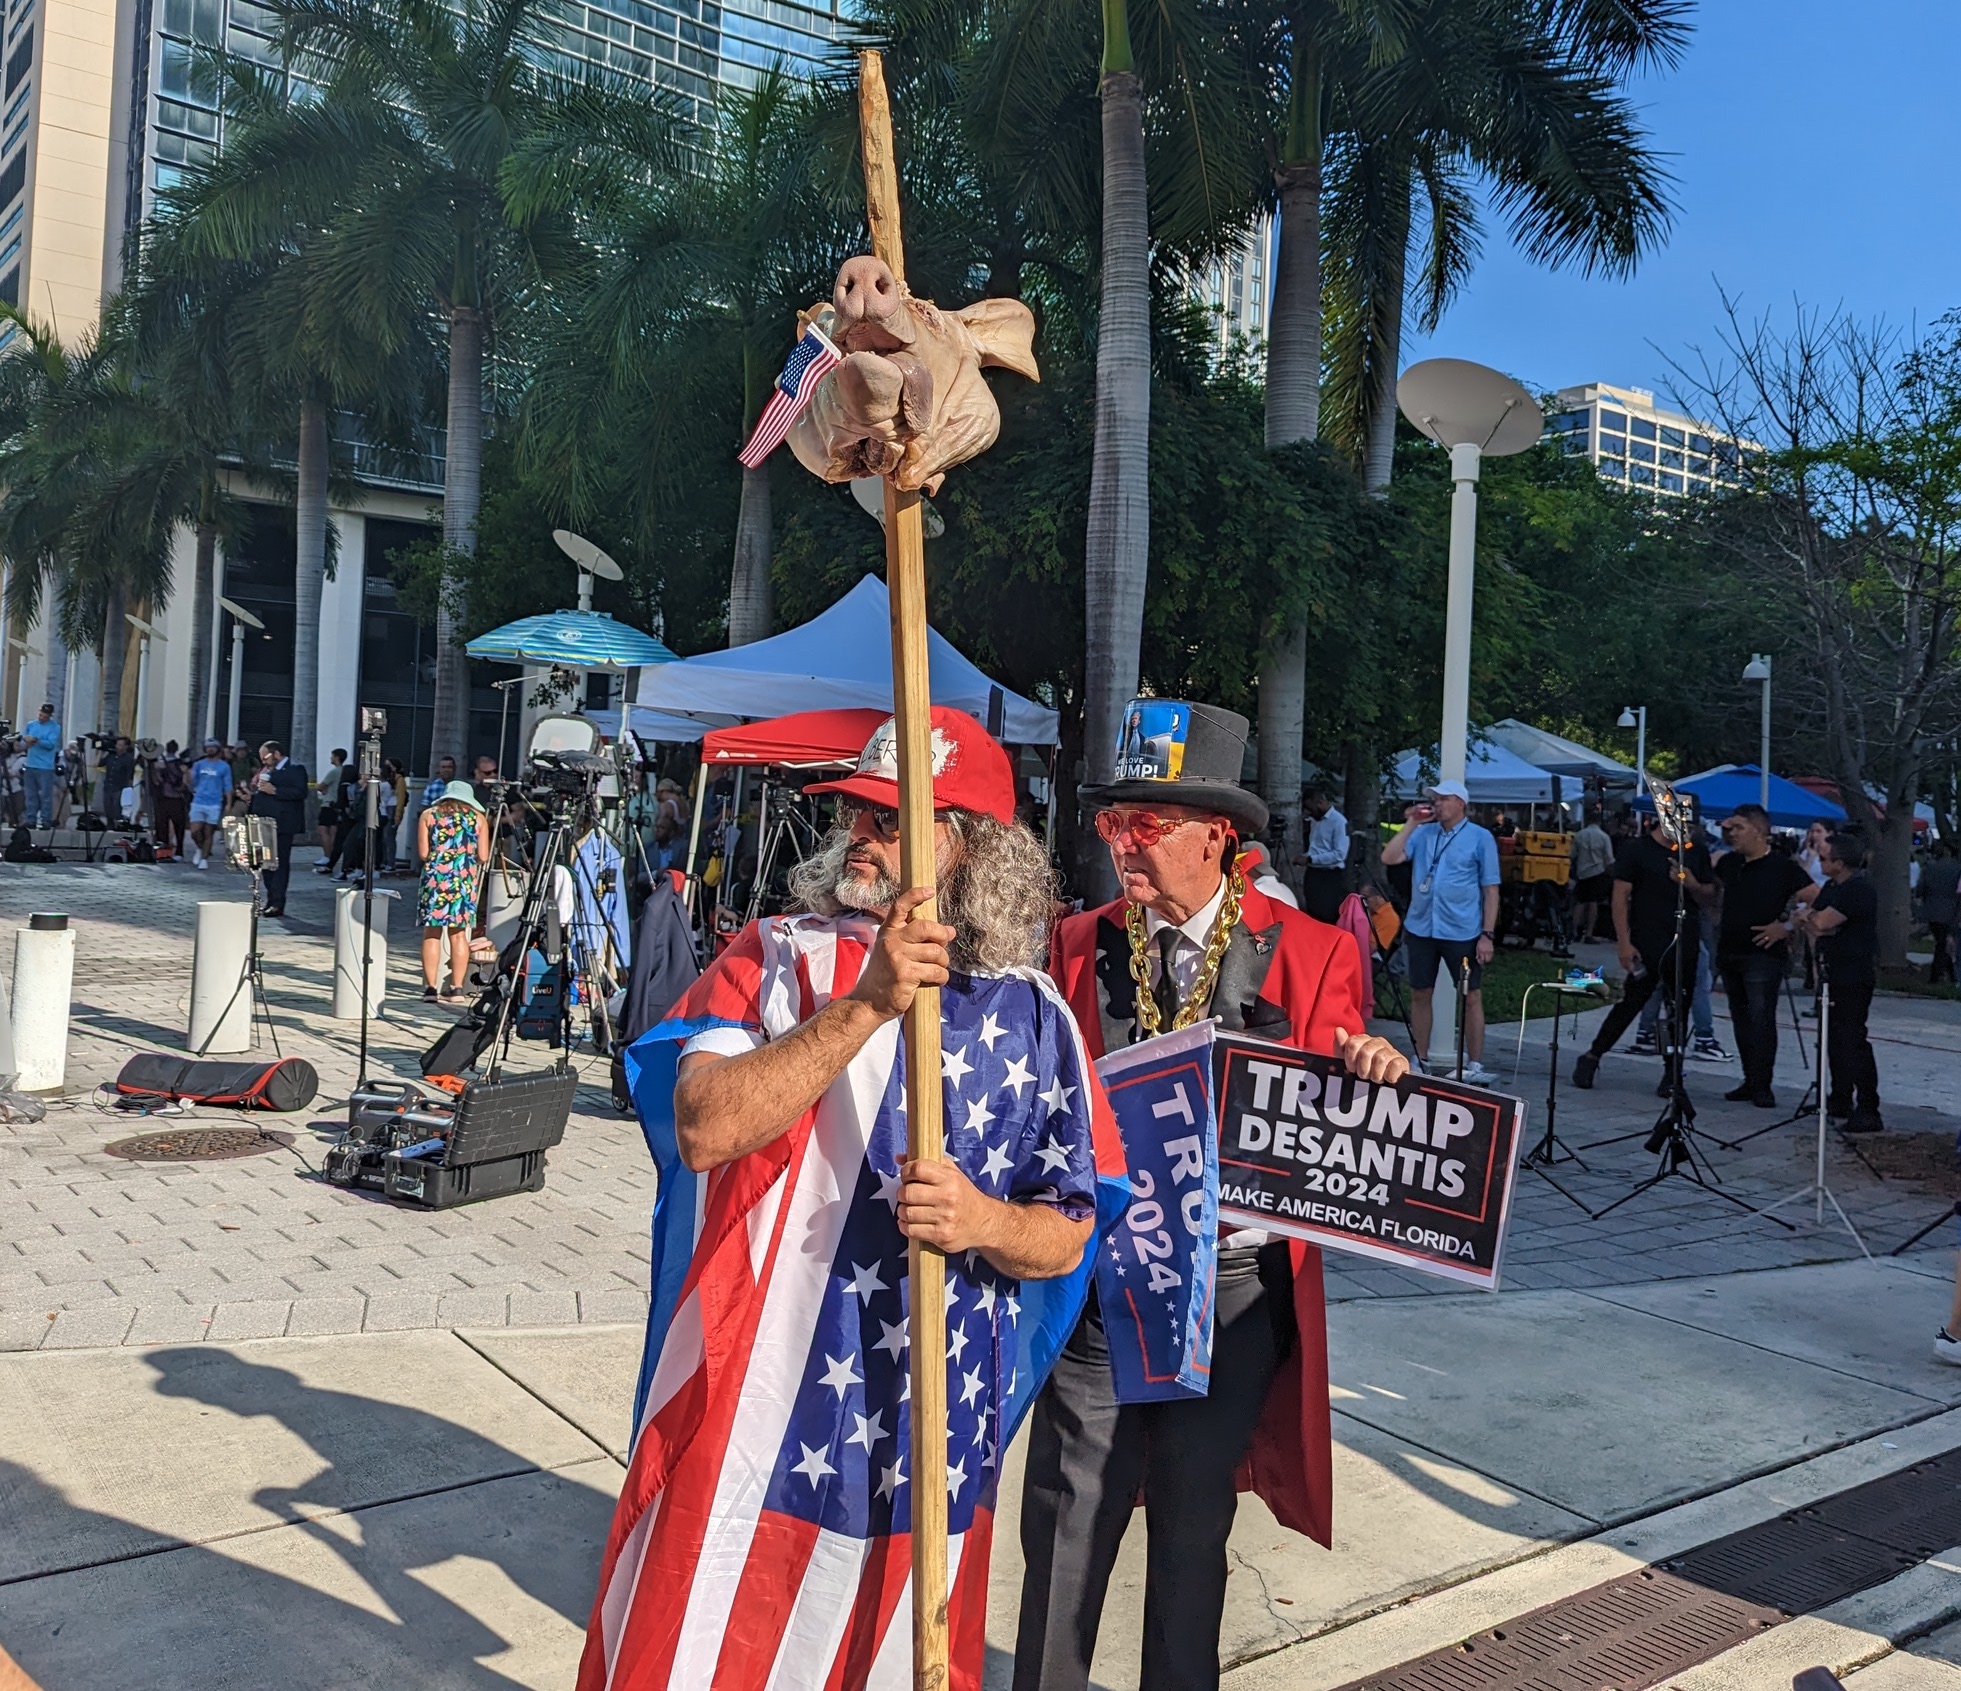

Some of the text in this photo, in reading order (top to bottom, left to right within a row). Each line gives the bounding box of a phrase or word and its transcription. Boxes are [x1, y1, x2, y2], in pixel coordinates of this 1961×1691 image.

[1115, 764, 1158, 778] RUMP!
[532, 986, 552, 994] LiveU
[1247, 1060, 1475, 1150] TRUMP
[1151, 1082, 1203, 1264] TRU
[1238, 1113, 1467, 1198] DESANTIS
[1304, 1168, 1390, 1206] 2024
[1126, 1169, 1182, 1294] 2024
[1218, 1183, 1476, 1260] MAKE AMERICA FLORIDA
